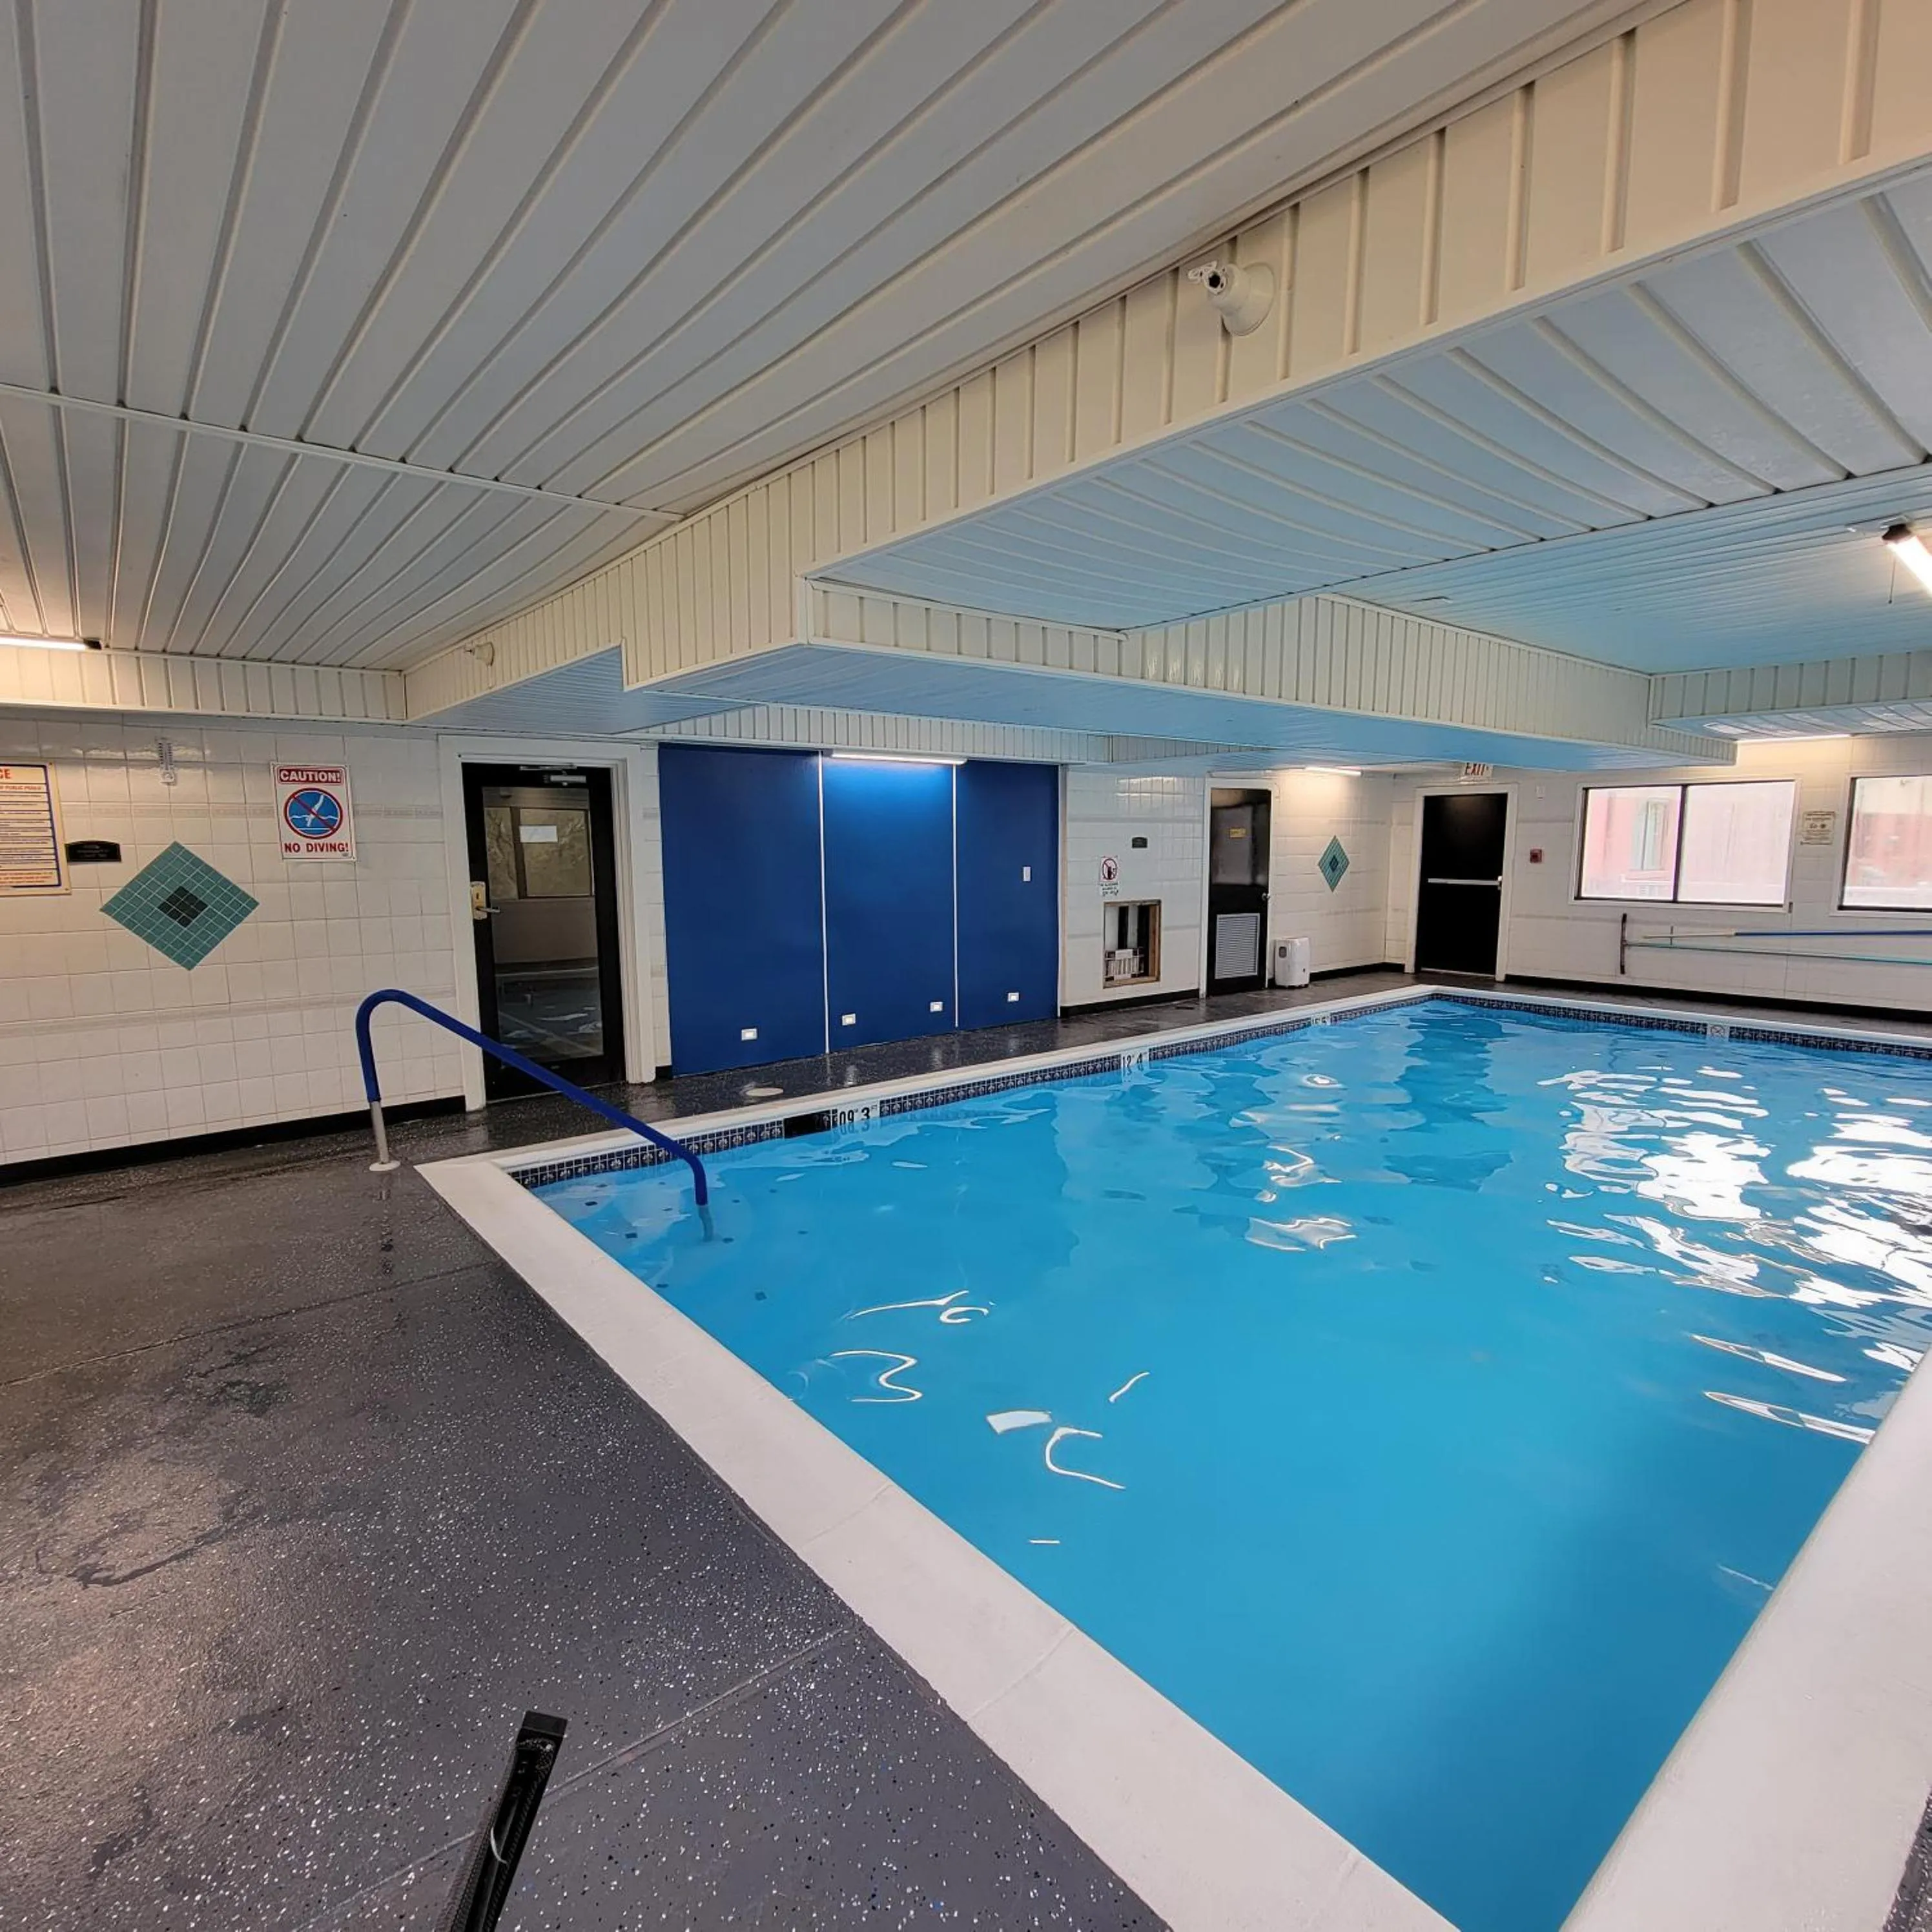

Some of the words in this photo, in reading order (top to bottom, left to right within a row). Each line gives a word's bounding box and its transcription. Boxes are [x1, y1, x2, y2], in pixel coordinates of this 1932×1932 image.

[280, 770, 341, 783] CAUTION!
[284, 842, 301, 853] NO
[306, 841, 349, 852] DIVING!
[861, 1107, 870, 1121] 3
